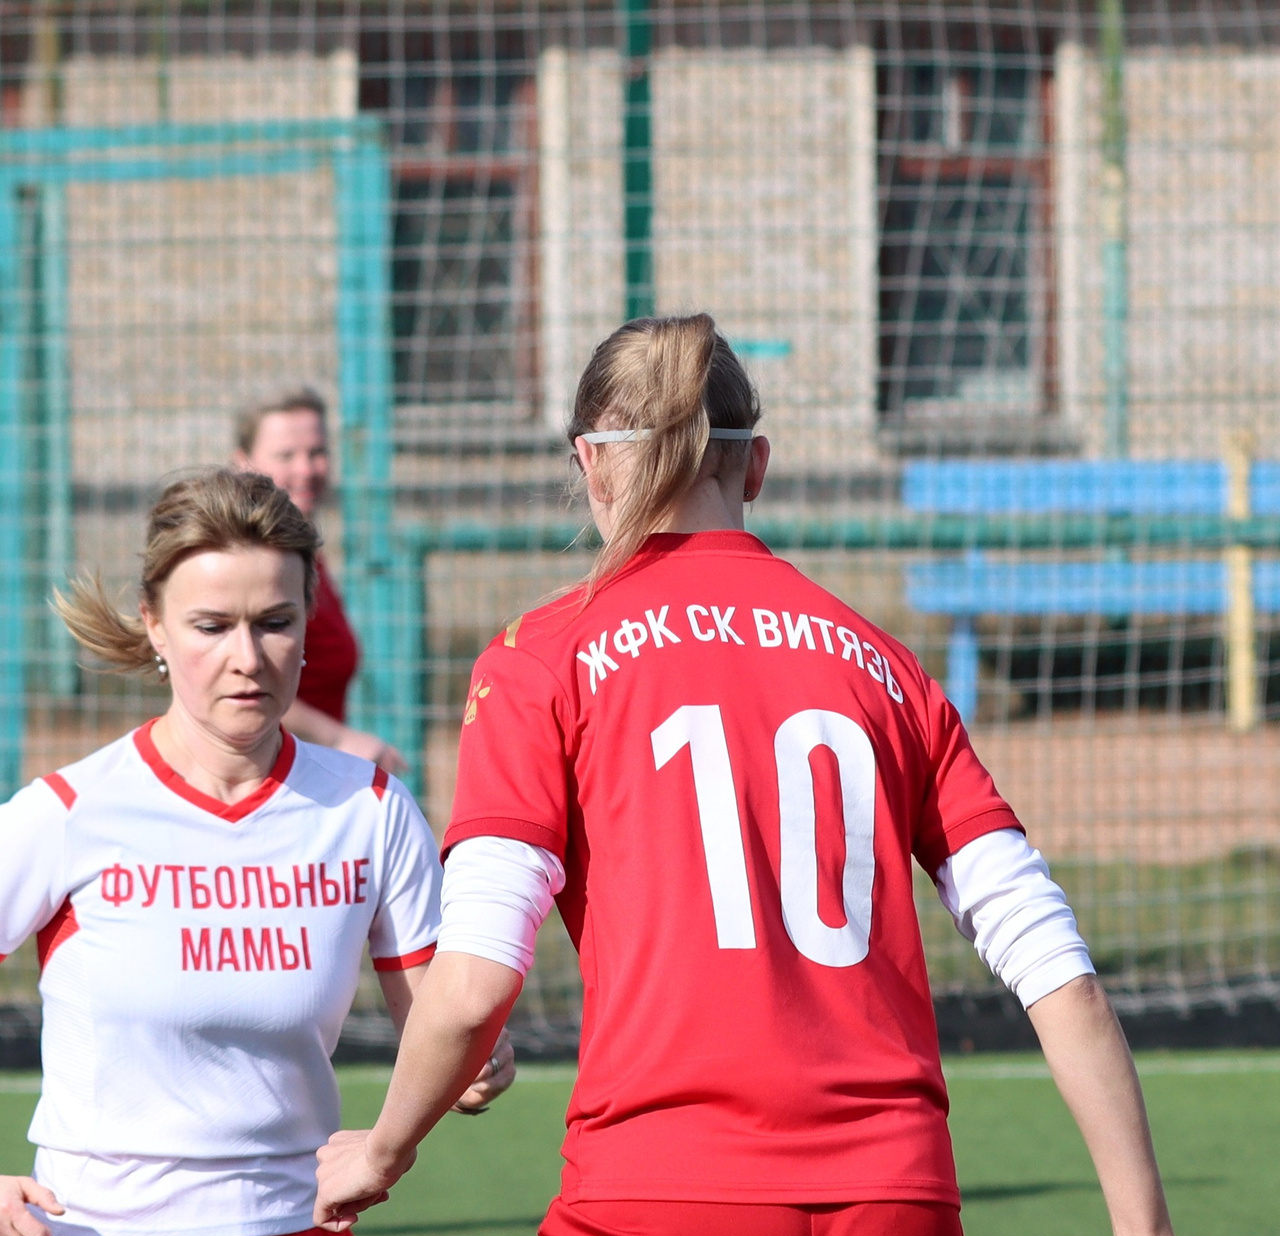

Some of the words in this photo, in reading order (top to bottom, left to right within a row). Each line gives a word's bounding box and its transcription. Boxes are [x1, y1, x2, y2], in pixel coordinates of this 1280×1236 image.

[576, 605, 681, 695] ЖФК
[686, 604, 745, 645] СК
[752, 607, 904, 704] ВИТЯЗЬ
[650, 703, 876, 967] 10
[101, 858, 370, 909] ФУТБОЛЬНЫЕ
[181, 926, 312, 972] МАМЫ
